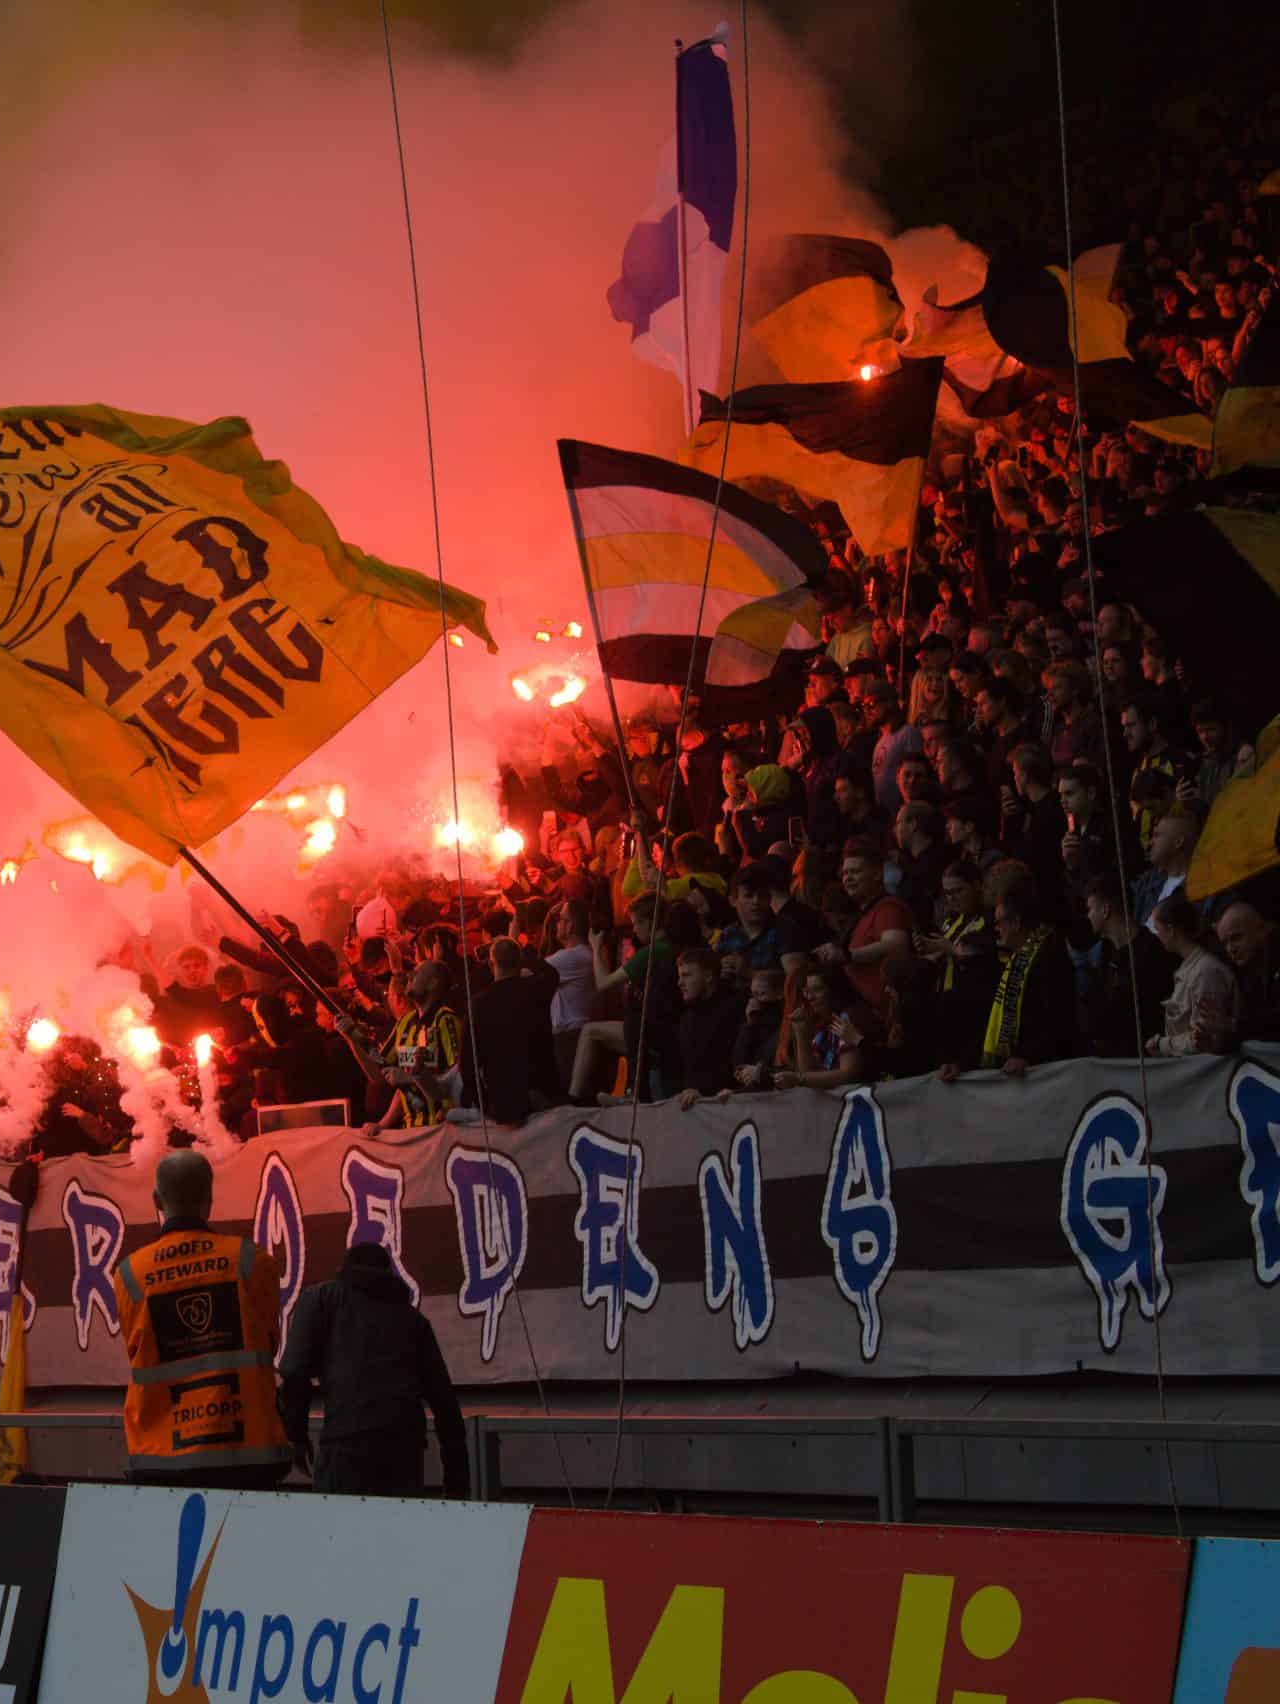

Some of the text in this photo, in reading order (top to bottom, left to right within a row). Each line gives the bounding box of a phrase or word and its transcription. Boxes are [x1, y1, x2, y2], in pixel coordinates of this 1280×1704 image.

[80, 474, 177, 533] all
[22, 516, 270, 706] MAD
[144, 1257, 229, 1287] STEWARD
[154, 1239, 214, 1263] HOOFD
